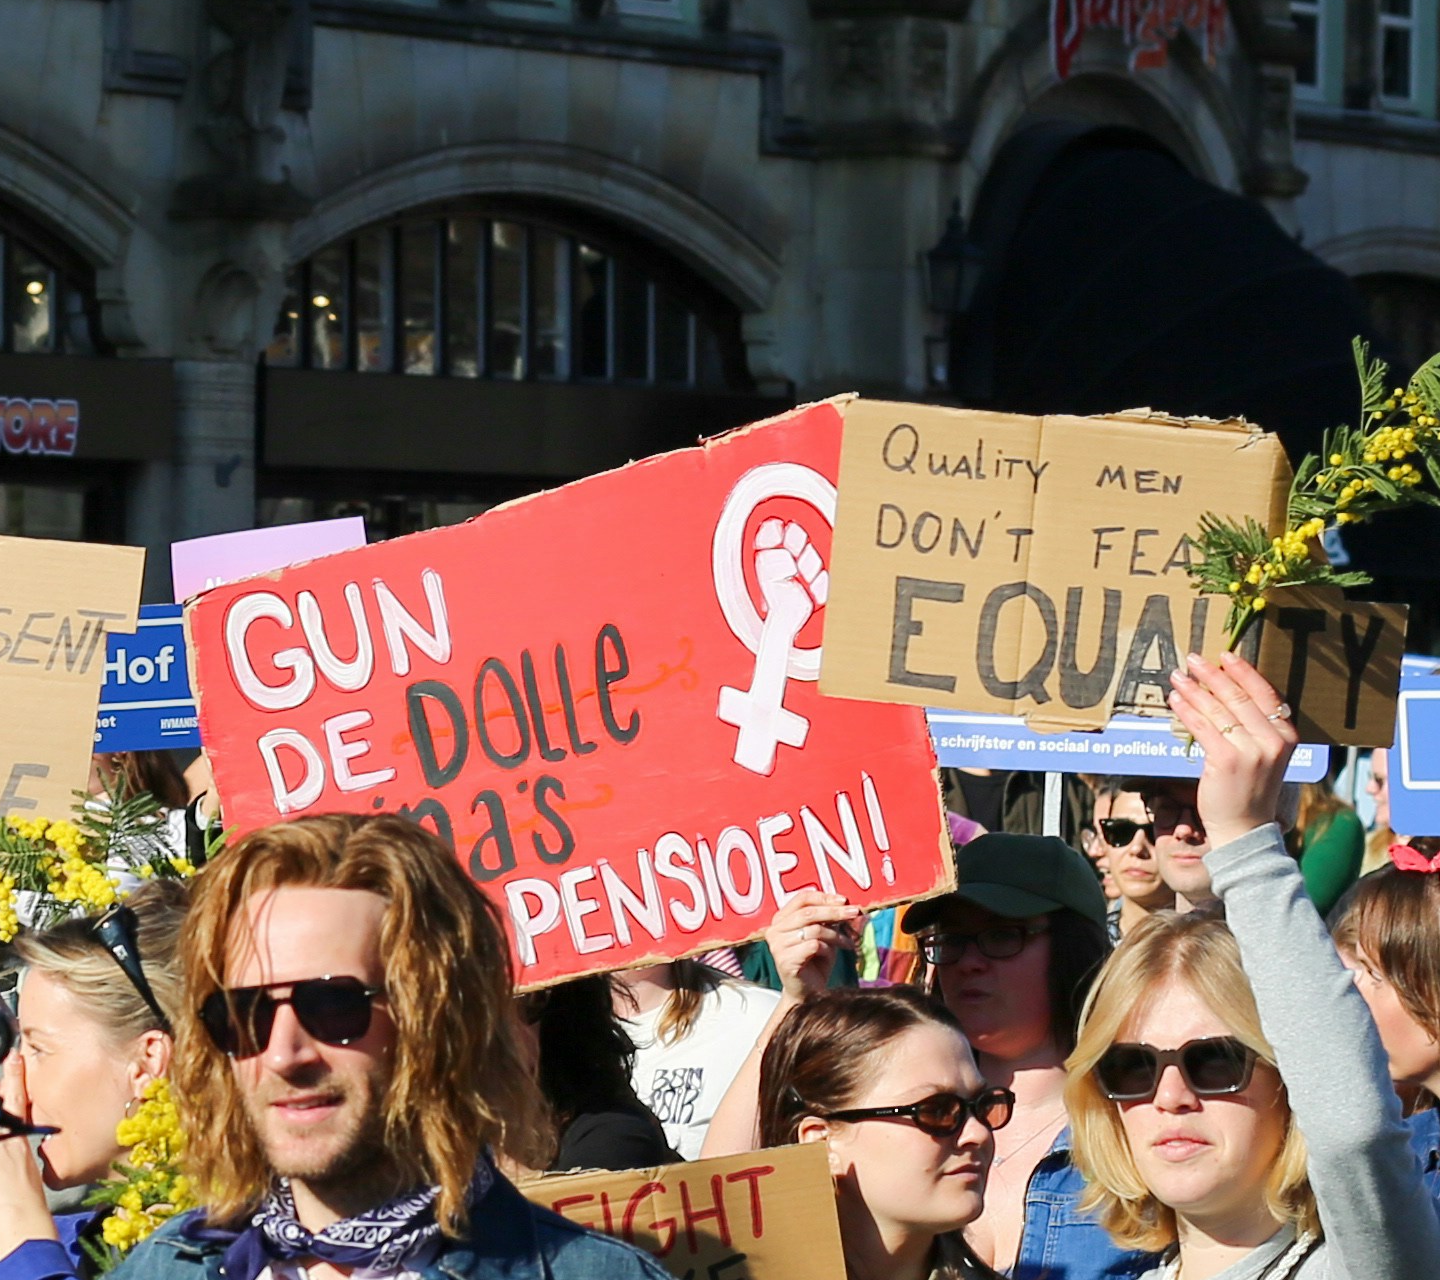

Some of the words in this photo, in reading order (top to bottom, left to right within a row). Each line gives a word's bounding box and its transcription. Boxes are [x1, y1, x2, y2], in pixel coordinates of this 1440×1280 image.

[1096, 464, 1184, 496] MEN
[876, 503, 1034, 564] DON'T
[1092, 525, 1198, 578] FEA
[102, 645, 175, 687] Hof
[224, 567, 451, 711] GUN
[258, 710, 397, 815] DE
[940, 733, 1015, 756] schrijfster
[1017, 739, 1037, 752] en
[1038, 737, 1090, 755] sociaal
[1092, 740, 1111, 755] en
[1113, 739, 1169, 758] politiek
[502, 768, 897, 966] PENSIOEN!
